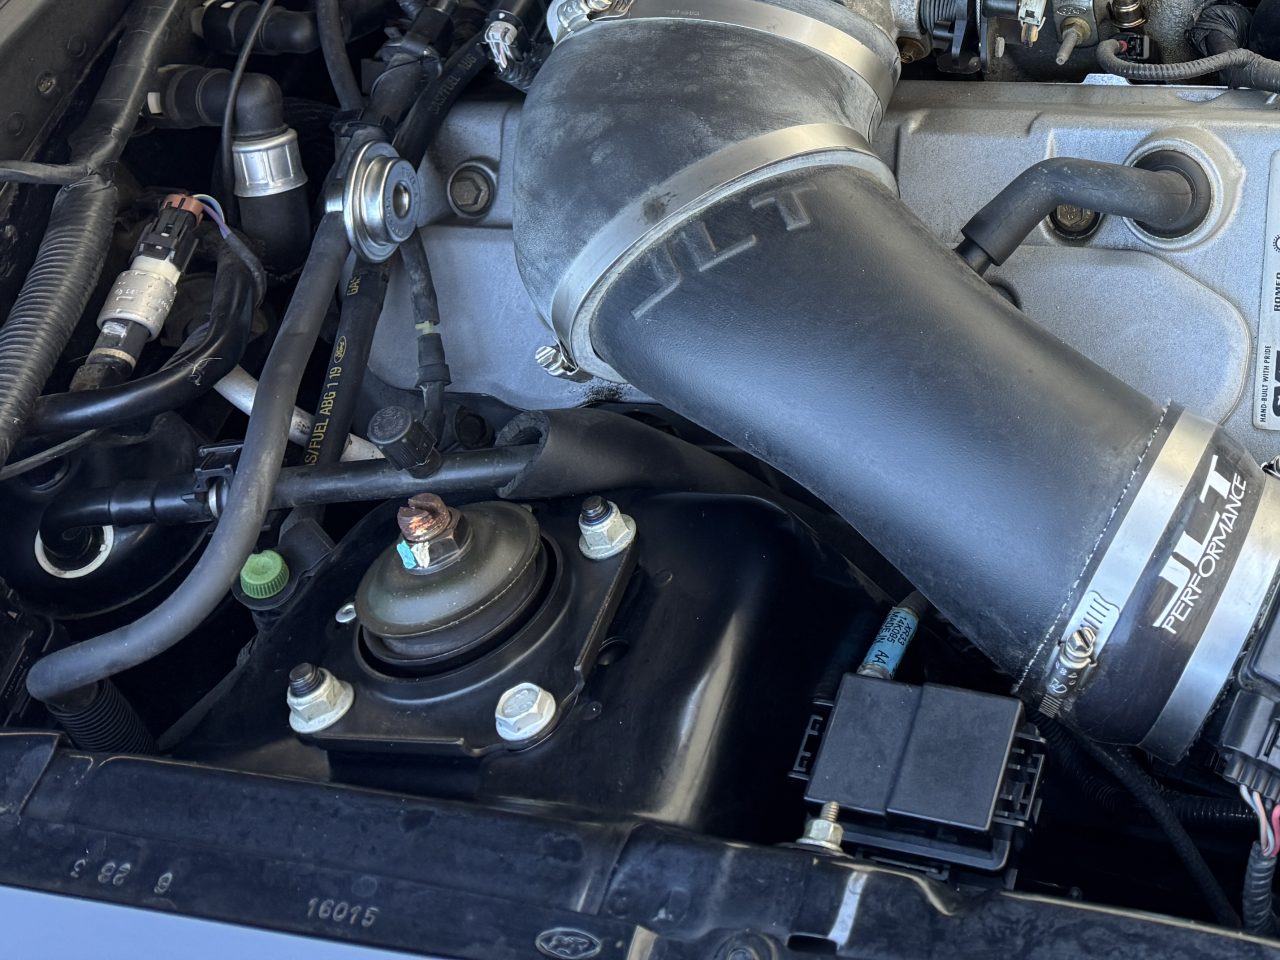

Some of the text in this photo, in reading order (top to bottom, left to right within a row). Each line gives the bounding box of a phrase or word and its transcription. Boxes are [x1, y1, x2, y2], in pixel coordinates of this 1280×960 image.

[320, 390, 337, 417] ABG
[329, 366, 342, 380] 19
[1260, 345, 1272, 423] HAND-BUILT WITH PRIDE
[1153, 454, 1231, 628] JLT
[1161, 473, 1247, 635] PERFORMANCE
[881, 611, 901, 633] MADE
[897, 622, 913, 646] XR33
[872, 649, 890, 665] AA
[306, 896, 379, 928] 16015
